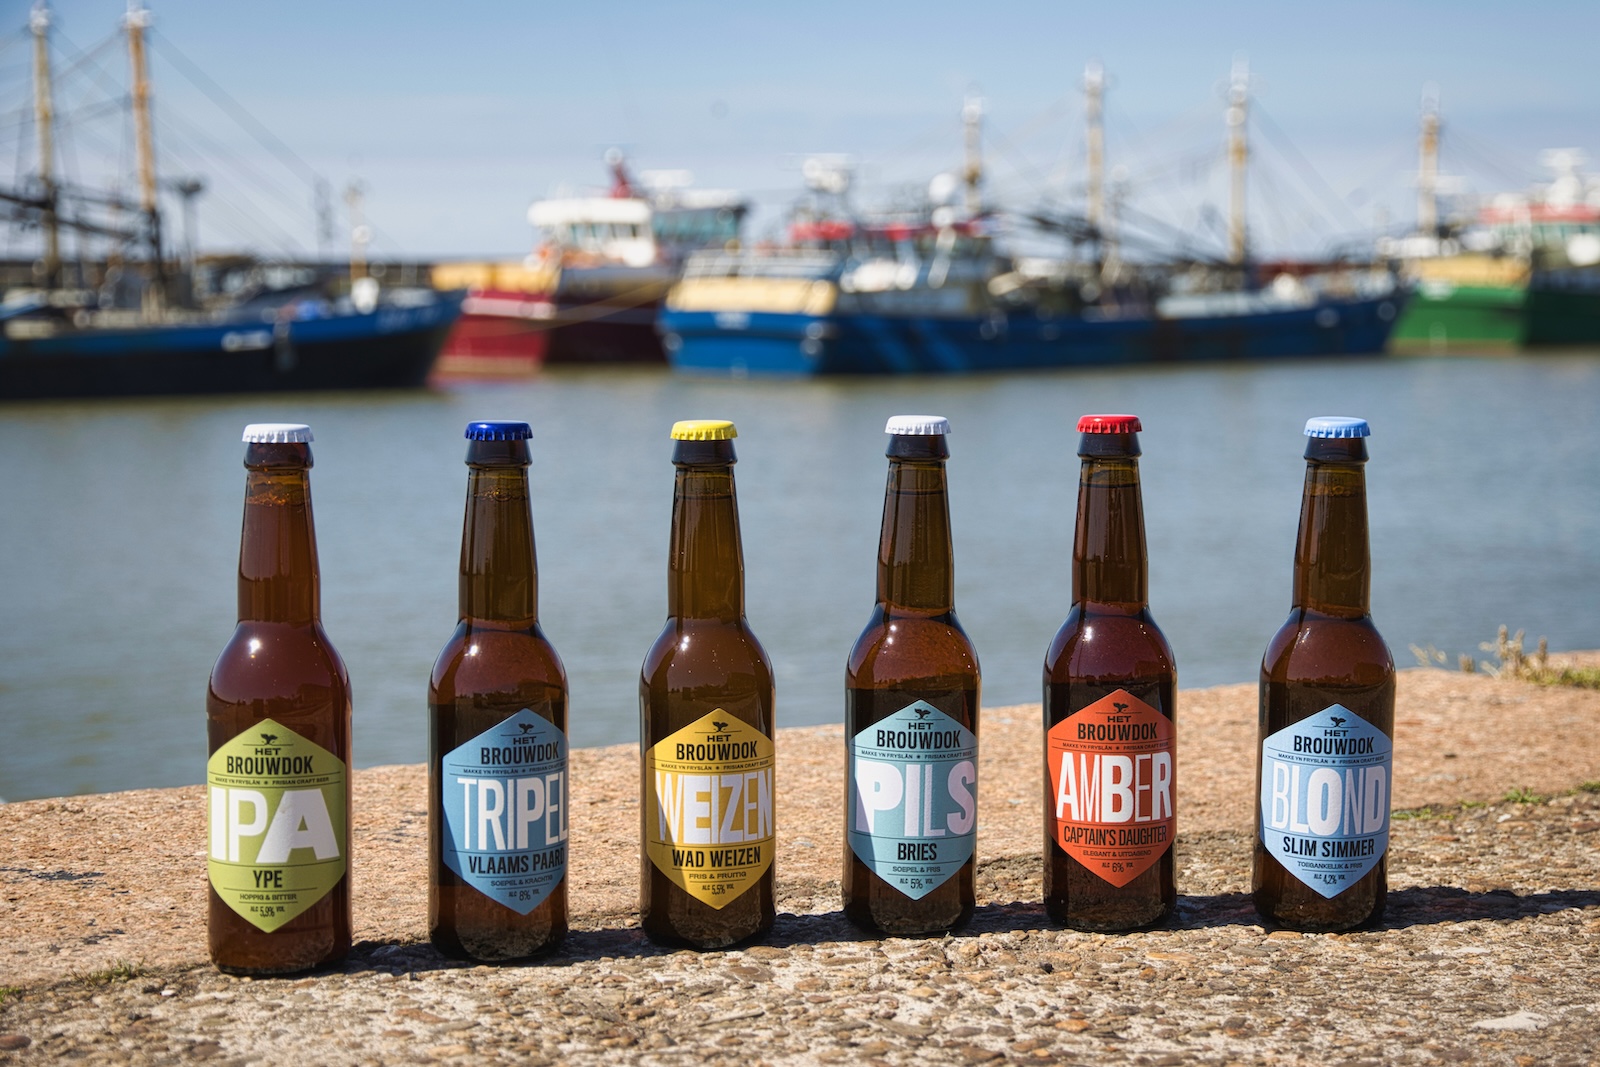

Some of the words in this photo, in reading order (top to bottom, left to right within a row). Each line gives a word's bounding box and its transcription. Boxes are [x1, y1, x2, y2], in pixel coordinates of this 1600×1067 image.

[513, 736, 536, 745] HET
[877, 730, 960, 749] BROUWDOK
[1078, 722, 1157, 741] BROUWDOK
[481, 741, 559, 765] BROUWDOK
[677, 740, 757, 761] BROUWDOK
[1294, 735, 1374, 754] BROUWDOK
[227, 756, 313, 775] BROUWDOK
[856, 760, 976, 836] PILS
[1056, 752, 1172, 823] AMBER
[1272, 760, 1386, 836] BLOND
[457, 771, 568, 850] TRIPEL
[655, 768, 772, 844] WEIZEN
[211, 786, 340, 863] IPA
[1064, 826, 1116, 846] CAPTAIN'S
[1119, 825, 1166, 846] DAUGHTER
[672, 849, 704, 867] WAD
[710, 846, 760, 867] WEIZEN
[898, 843, 937, 860] BRIES
[1283, 836, 1316, 856] SLIM
[1322, 839, 1374, 858] SIMMER
[469, 856, 528, 874] VLAAMS
[533, 847, 564, 871] PAARD
[1112, 863, 1124, 872] 6%
[253, 870, 282, 888] YPE
[910, 879, 923, 889] 5%
